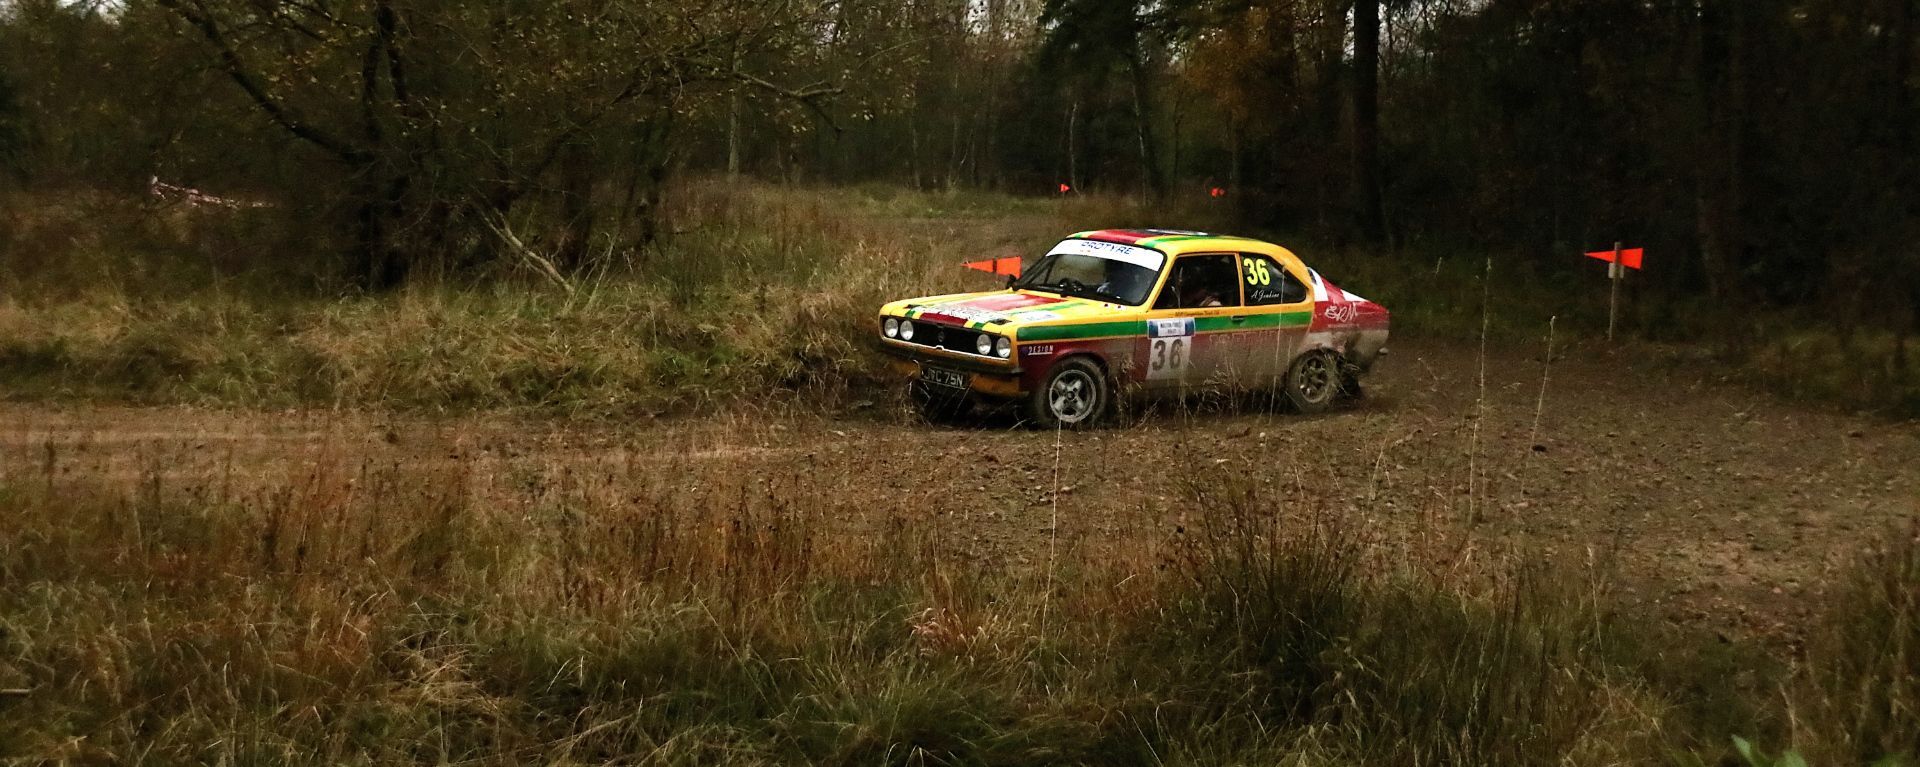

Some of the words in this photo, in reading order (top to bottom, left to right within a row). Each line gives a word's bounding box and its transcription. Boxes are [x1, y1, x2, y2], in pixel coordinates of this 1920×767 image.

[1081, 241, 1135, 255] PROTYRE
[1243, 258, 1271, 286] 36
[1152, 339, 1183, 371] 36
[944, 371, 964, 387] 75N
